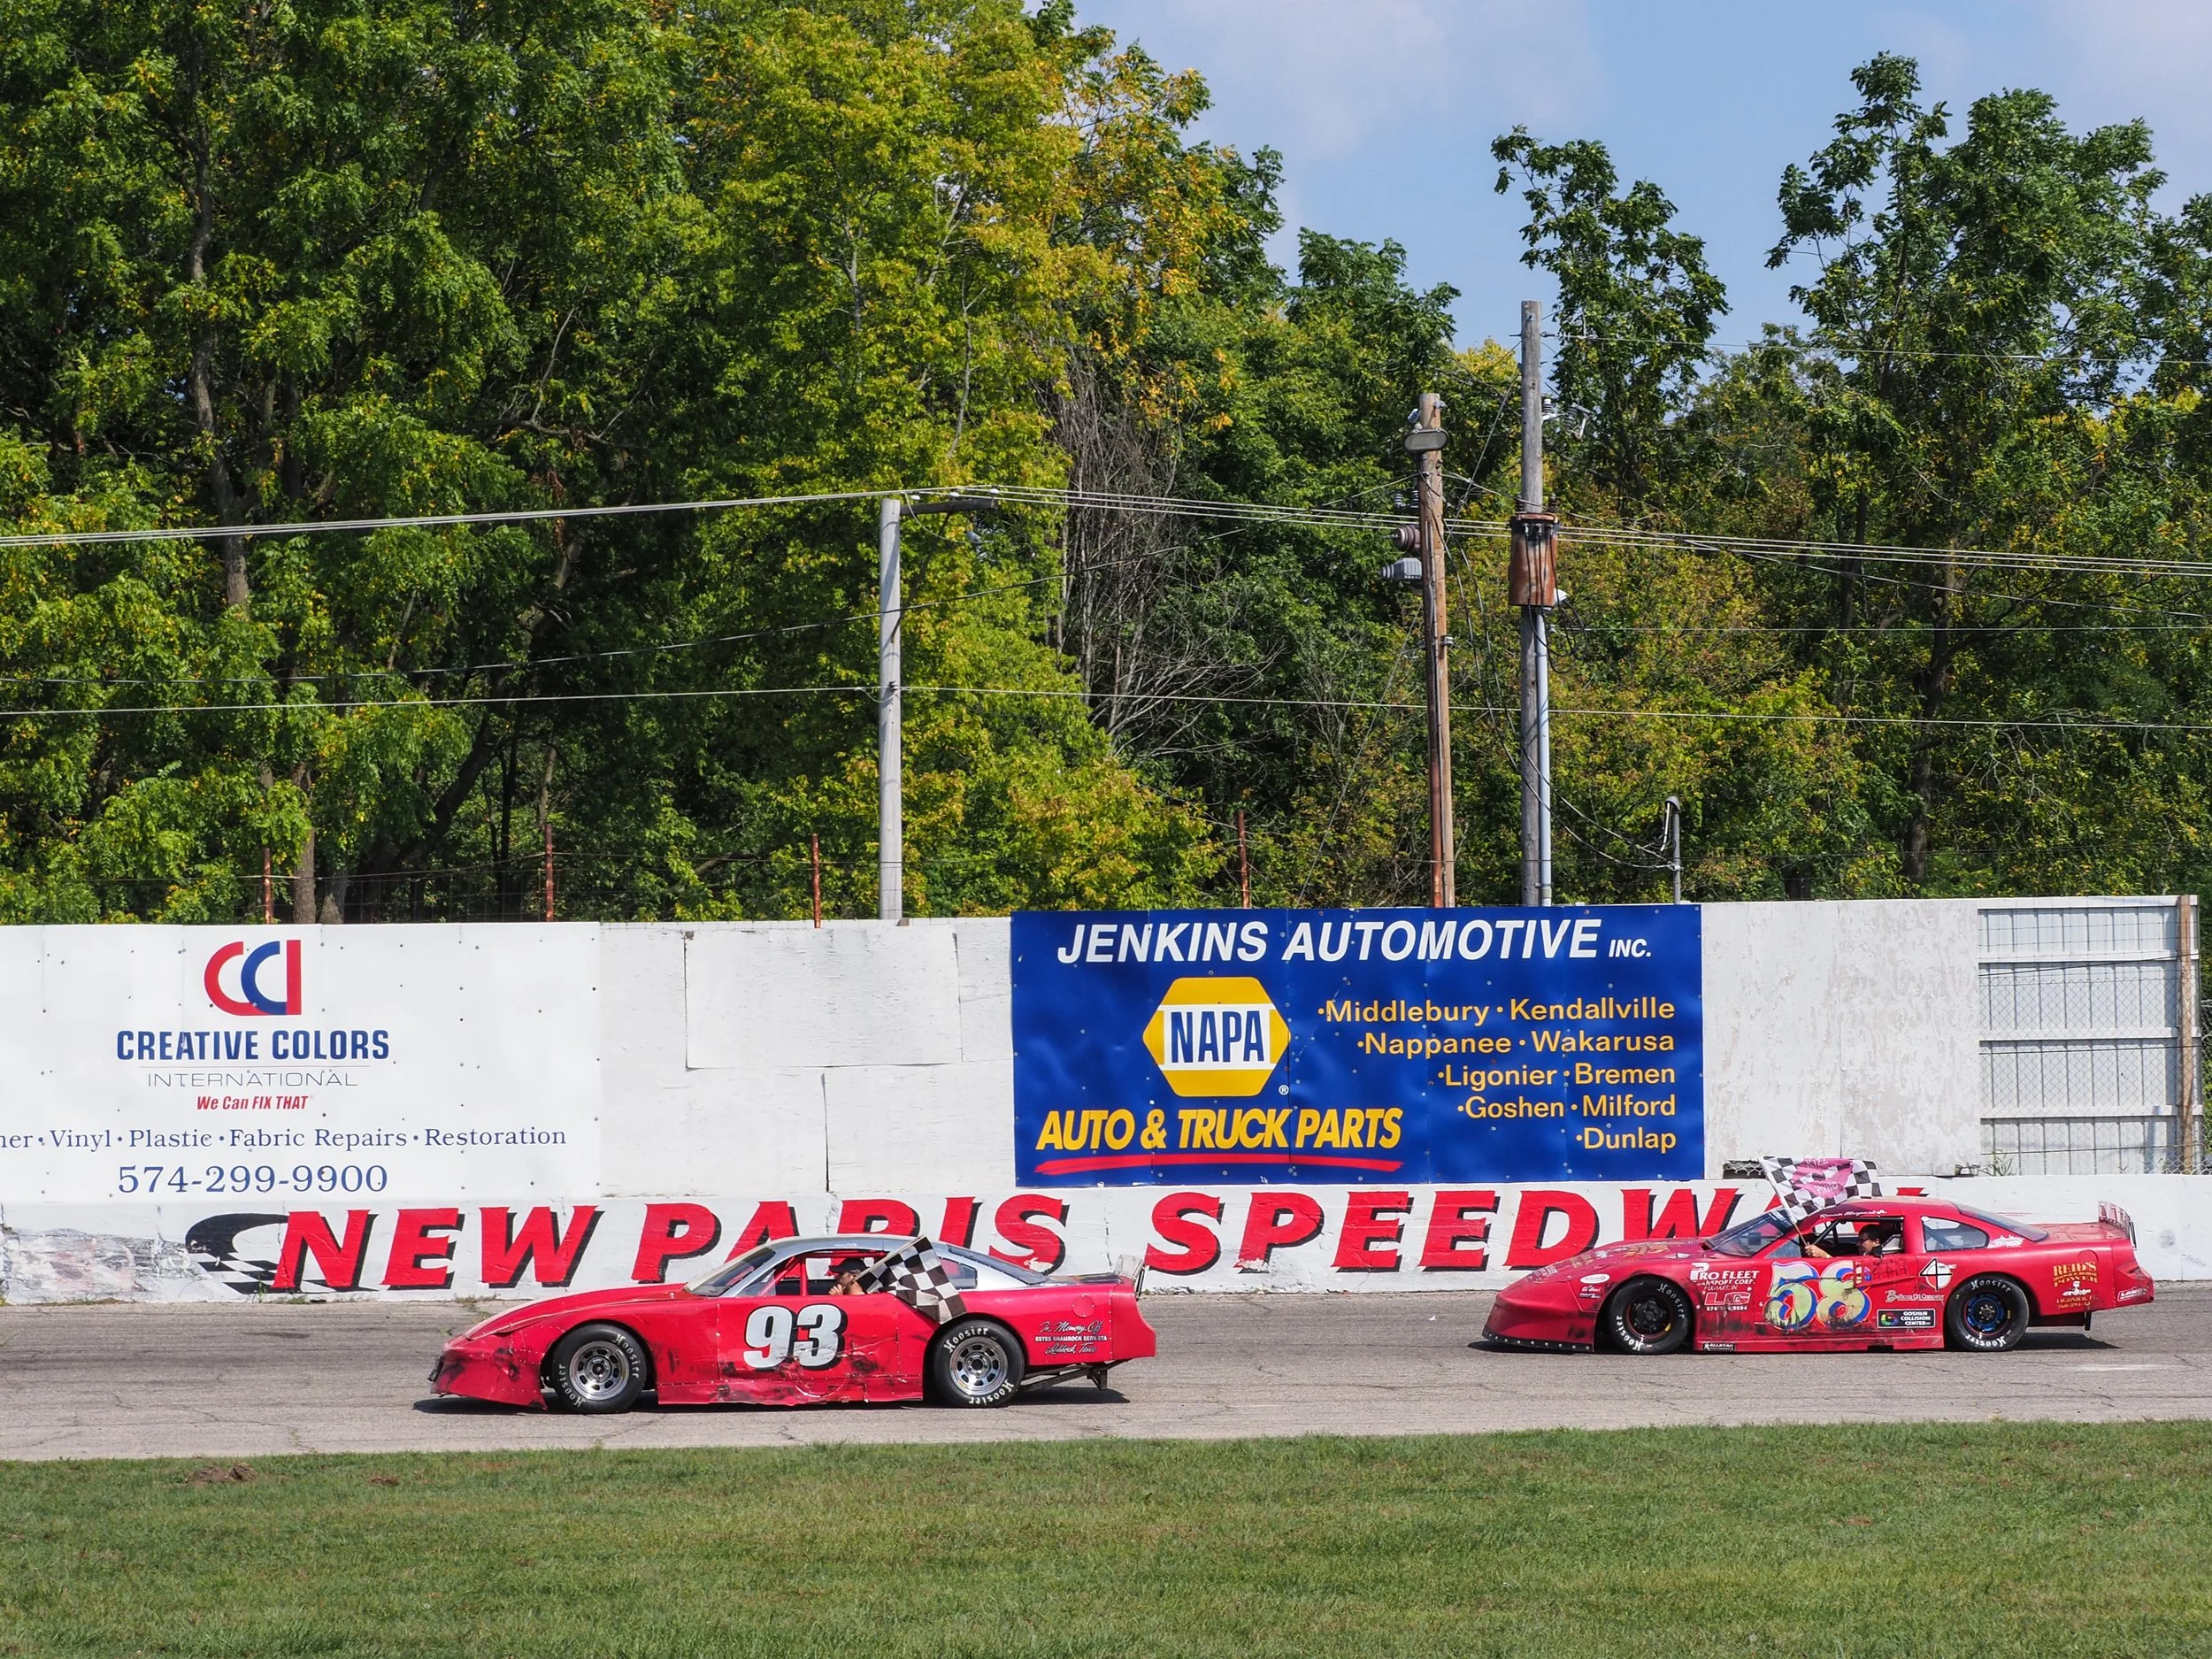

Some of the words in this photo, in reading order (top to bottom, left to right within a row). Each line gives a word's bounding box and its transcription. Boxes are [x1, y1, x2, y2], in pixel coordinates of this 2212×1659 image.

[1057, 921, 1269, 964] JENKINS
[1281, 918, 1602, 962] AUTOMOTIVE
[1609, 938, 1651, 958] INC.
[1325, 1000, 1489, 1025] Middlebury
[1510, 997, 1675, 1020] Kendallville
[116, 1029, 259, 1061] CREATIVE
[271, 1029, 390, 1061] COLORS
[1170, 1010, 1265, 1064] NAPA
[1365, 1032, 1511, 1059] Nappanee
[1532, 1031, 1674, 1052] Wakarusa
[148, 1070, 357, 1087] INTERNATIONAL
[1446, 1064, 1557, 1090] Ligonier
[1575, 1062, 1674, 1085] Bremen
[197, 1096, 219, 1110] We
[223, 1096, 249, 1110] Can
[252, 1096, 272, 1110] FIX
[276, 1095, 308, 1110] THAT
[1465, 1096, 1564, 1118] Goshen
[1583, 1094, 1676, 1117] Milford
[50, 1129, 111, 1152] Vinyl
[129, 1129, 212, 1148] Plastic
[229, 1128, 306, 1147] Fabric
[315, 1128, 407, 1150] Repairs
[425, 1128, 566, 1146] Restoration
[1036, 1109, 1135, 1151] AUTO
[1140, 1109, 1167, 1149] &
[1178, 1108, 1293, 1149] TRUCK
[1294, 1107, 1403, 1148] PARTS
[1585, 1128, 1677, 1153] Dunlap
[118, 1164, 388, 1194] 574-299-9900
[271, 1204, 604, 1293] NEW
[1147, 1187, 1927, 1276] SPEEDW
[1689, 1262, 1720, 1281] PRO
[1722, 1270, 1760, 1280] FLEET
[1970, 1279, 2011, 1292] Hoosier
[1656, 1282, 1686, 1318] Hoosier
[1763, 1259, 1873, 1330] 58
[742, 1303, 848, 1371] 93
[943, 1326, 989, 1354] Hoosier
[1616, 1314, 1645, 1352] Hoosier
[612, 1333, 640, 1379] Hoosier
[557, 1363, 587, 1409] Hoosier
[969, 1379, 1015, 1406] Hoosier
